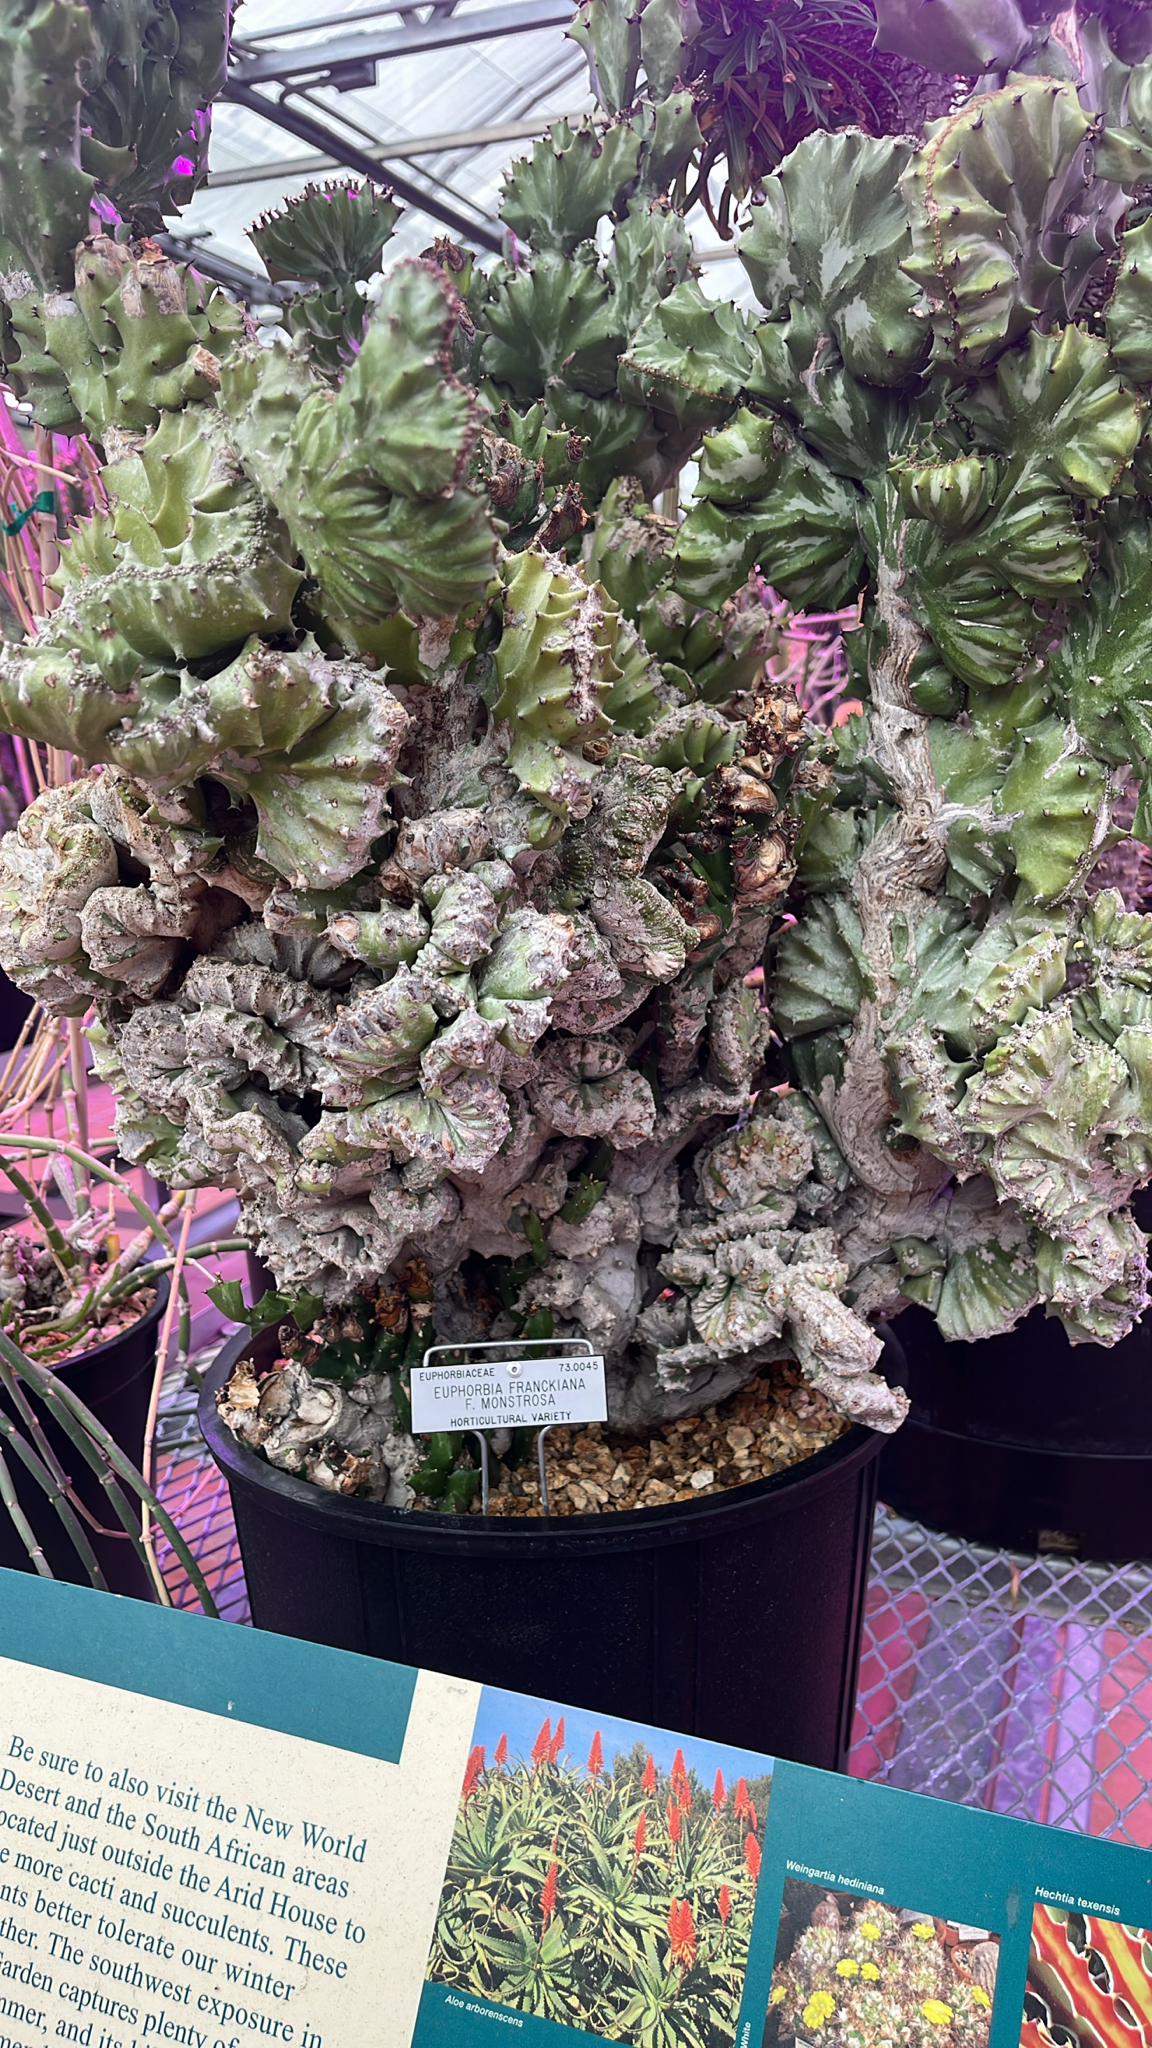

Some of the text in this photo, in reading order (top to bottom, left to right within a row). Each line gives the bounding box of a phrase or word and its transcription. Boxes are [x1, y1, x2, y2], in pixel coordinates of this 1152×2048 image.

[420, 1361, 599, 1381] EUPHORBIACEAE 73.0045
[434, 1378, 586, 1399] EUPHORBIA FRANCKIANA
[450, 1411, 572, 1427] HORTICULTURAL VARIETY
[466, 1394, 556, 1411] F. MONSTROSA
[7, 1735, 367, 1863] Be sure to also visit the New World
[0, 1768, 349, 1898] Desert and the South African areas
[57, 1824, 97, 1856] just
[102, 1844, 173, 1881] outside
[179, 1864, 210, 1892] the
[214, 1876, 265, 1910] Arid
[268, 1891, 337, 1934] House
[345, 1918, 366, 1944] to
[786, 1859, 885, 1895] Weingartia hediniana
[14, 1852, 63, 1882] more
[69, 1872, 116, 1900] cacti
[120, 1889, 158, 1914] and
[162, 1902, 274, 1956] succulents.
[284, 1935, 347, 1979] These
[1034, 1886, 1121, 1916] Hechtia texensis
[35, 1889, 92, 1930] better
[97, 1915, 175, 1960] tolerate
[181, 1949, 218, 1975] our
[225, 1961, 296, 2002] winter
[49, 1931, 84, 1965] The
[89, 1954, 192, 2005] southwest
[197, 1993, 294, 2041] exposure
[301, 2022, 322, 2048] in
[59, 1981, 139, 2025] captures
[141, 2011, 208, 2048] plenty
[444, 1994, 524, 2028] Aloe arborenscens
[55, 2019, 93, 2047] and
